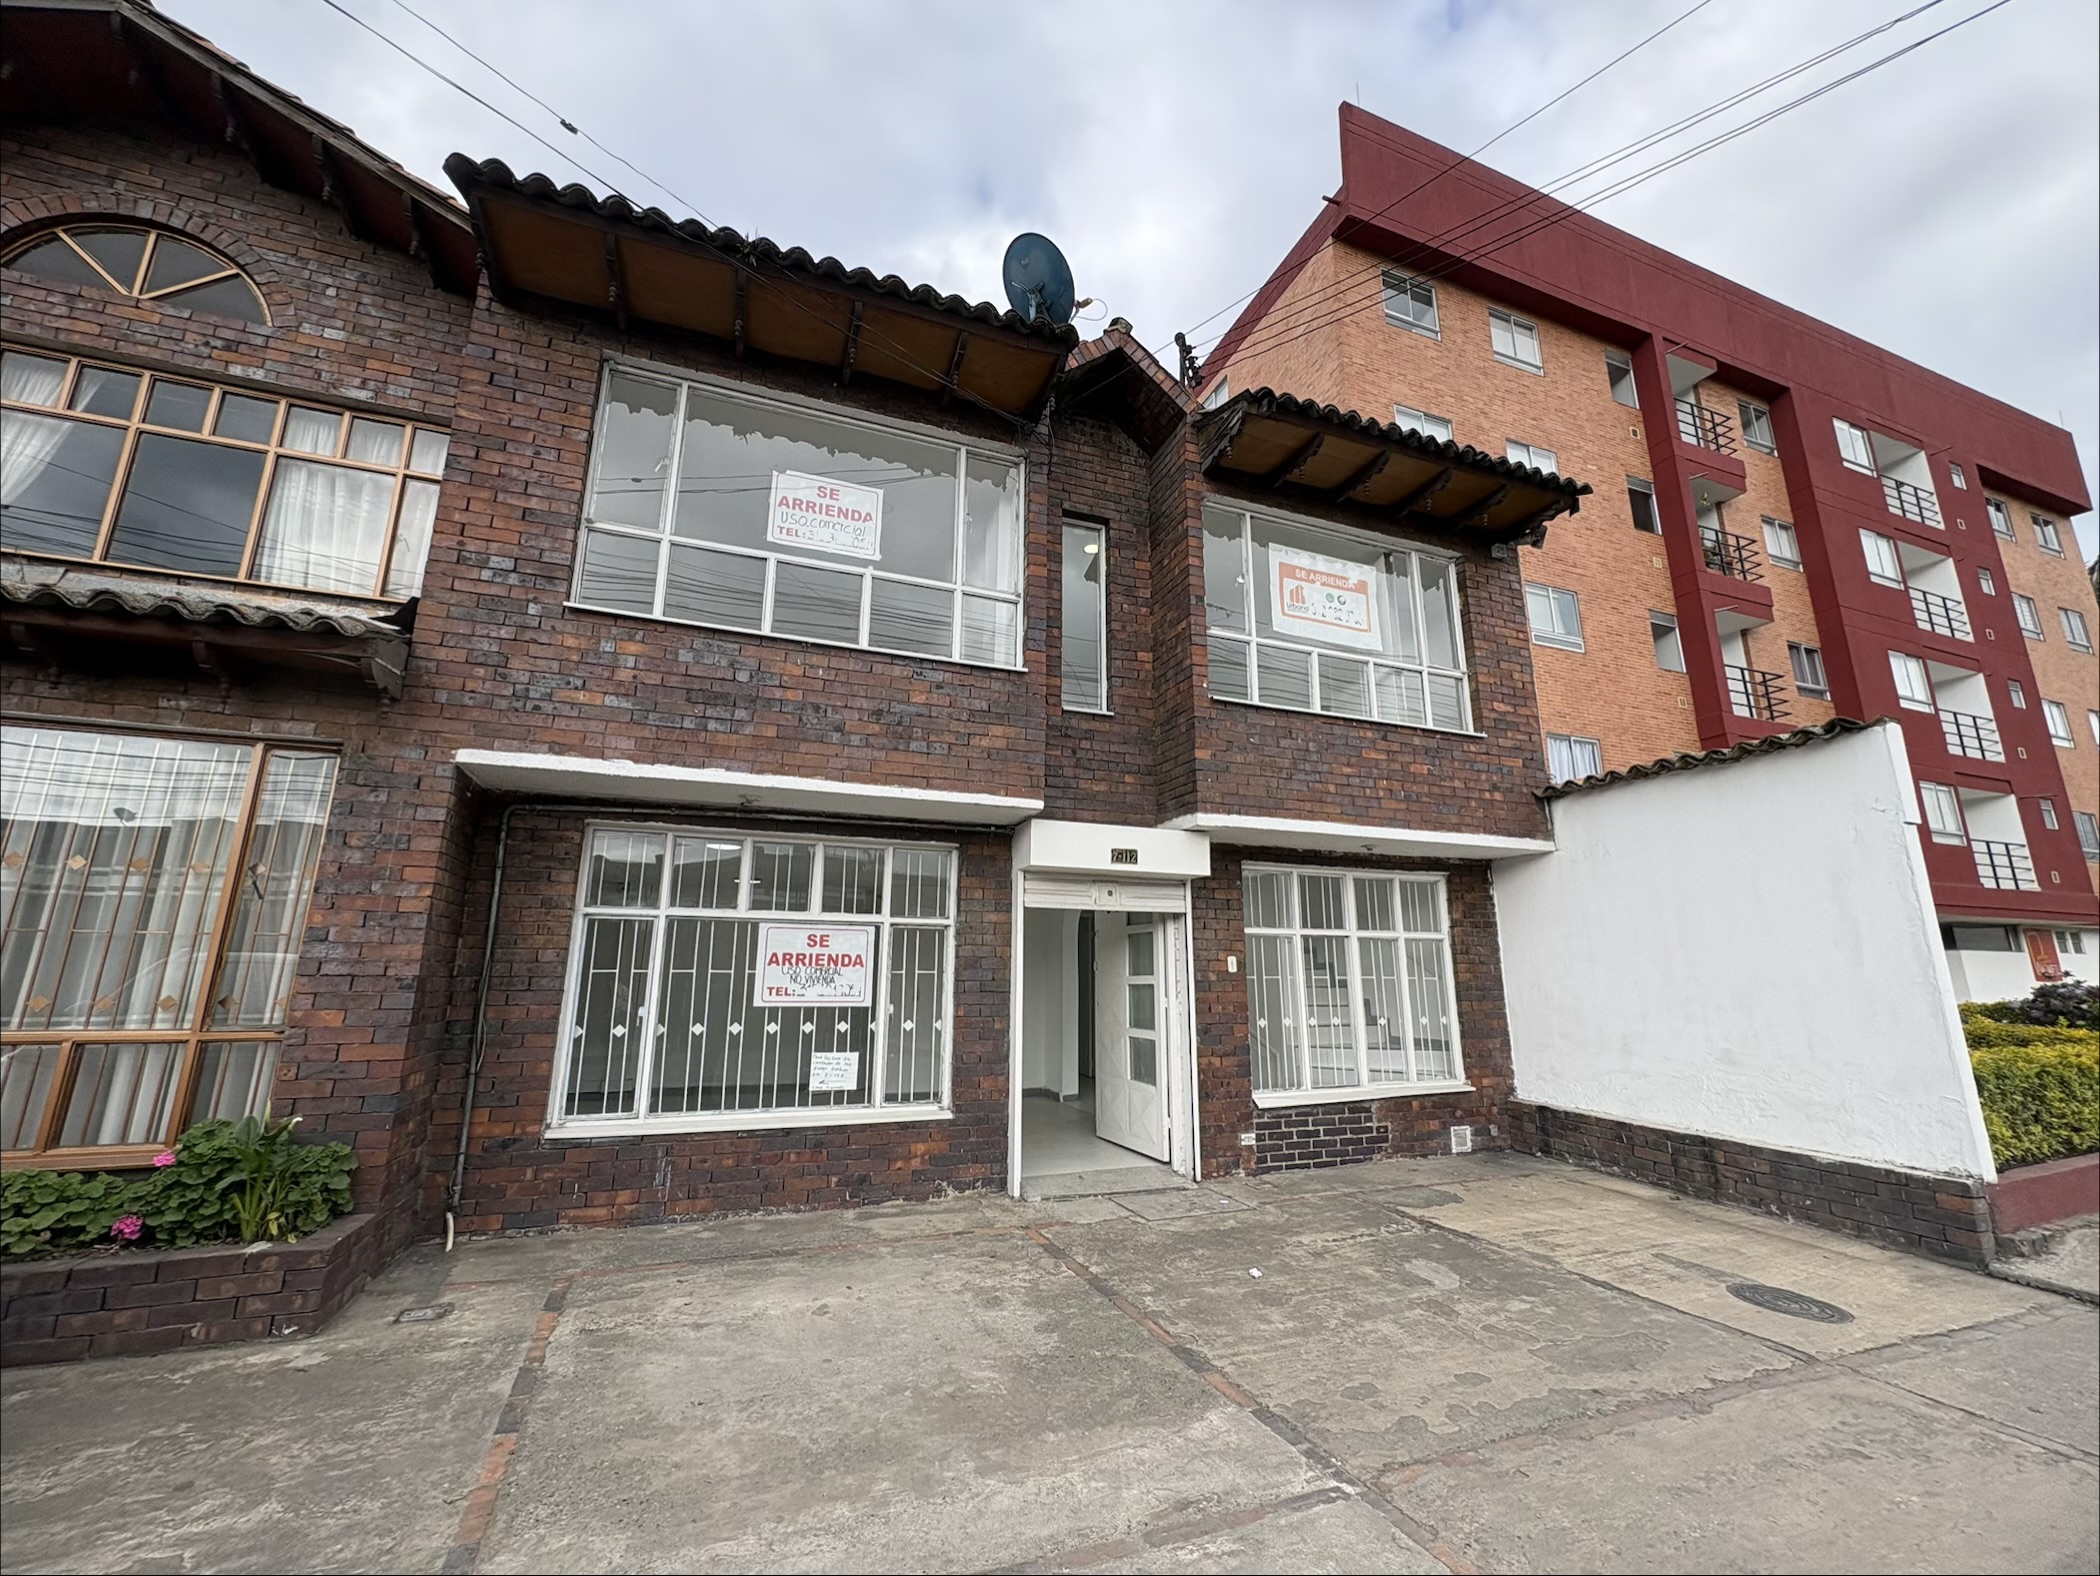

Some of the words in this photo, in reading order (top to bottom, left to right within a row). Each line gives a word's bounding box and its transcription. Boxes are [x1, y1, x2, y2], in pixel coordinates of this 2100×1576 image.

[816, 485, 840, 501] SE
[777, 495, 874, 524] ARRIENDA
[777, 525, 806, 539] TEL:
[1295, 569, 1308, 580] SE
[1308, 572, 1356, 590] ARRIENDA
[806, 933, 831, 949] SE
[767, 952, 865, 968] ARRIENDA
[781, 965, 802, 976] USO
[788, 974, 804, 986] NO
[767, 986, 796, 997] TEL:
